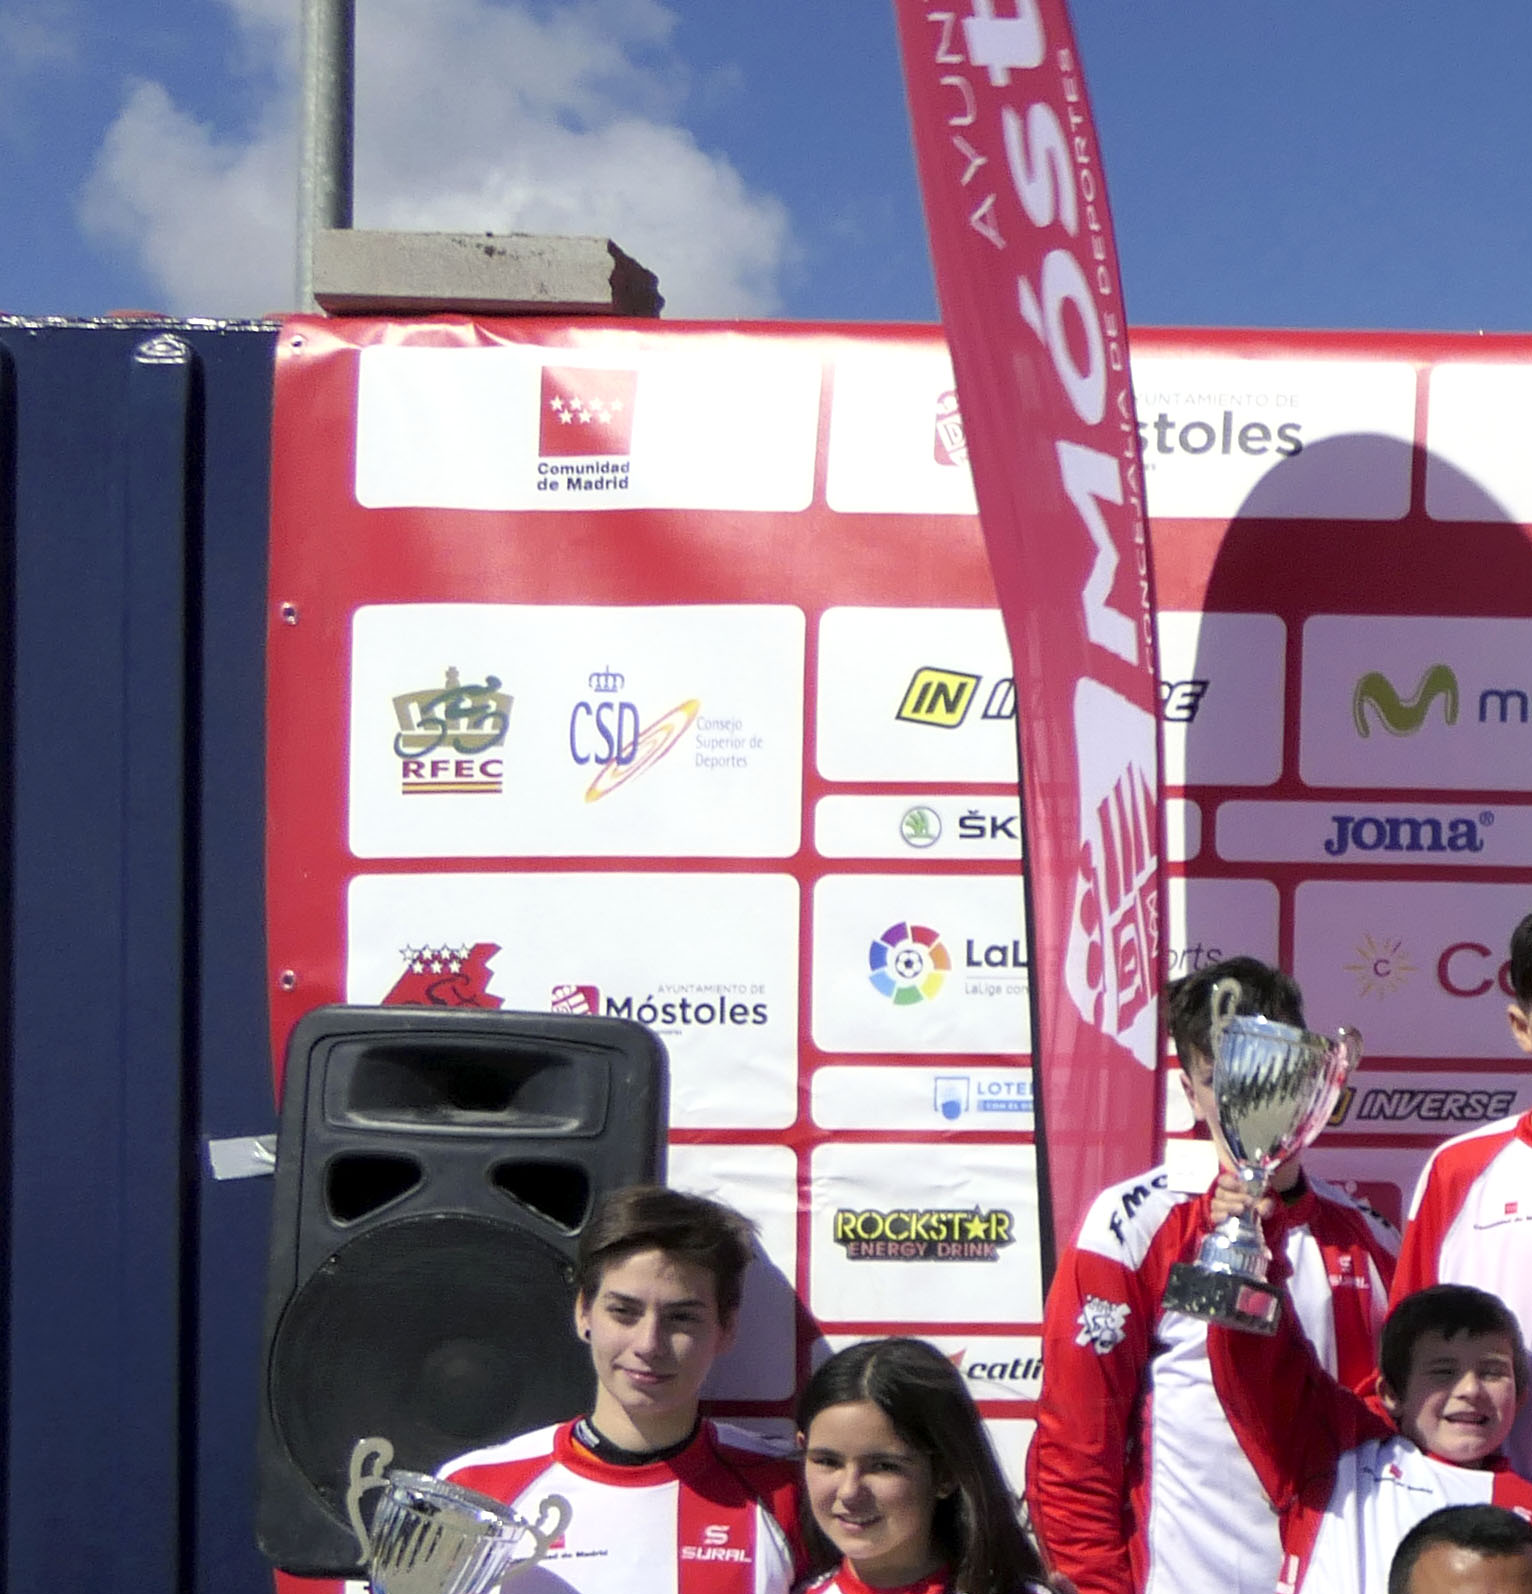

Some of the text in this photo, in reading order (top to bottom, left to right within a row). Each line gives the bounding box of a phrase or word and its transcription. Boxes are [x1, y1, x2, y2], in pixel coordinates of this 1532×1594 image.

[537, 460, 631, 476] Comunidad
[537, 475, 630, 492] de Madrid
[696, 715, 743, 734] Consejo
[569, 701, 641, 767] CSD
[695, 734, 764, 752] Superior de
[401, 759, 504, 779] RFEC
[694, 752, 748, 770] Deportes
[1357, 1088, 1517, 1121] INVERSE
[849, 1241, 997, 1258] ENERGY DRINK
[967, 1357, 1044, 1381] catli
[681, 1545, 753, 1563] SURAL
